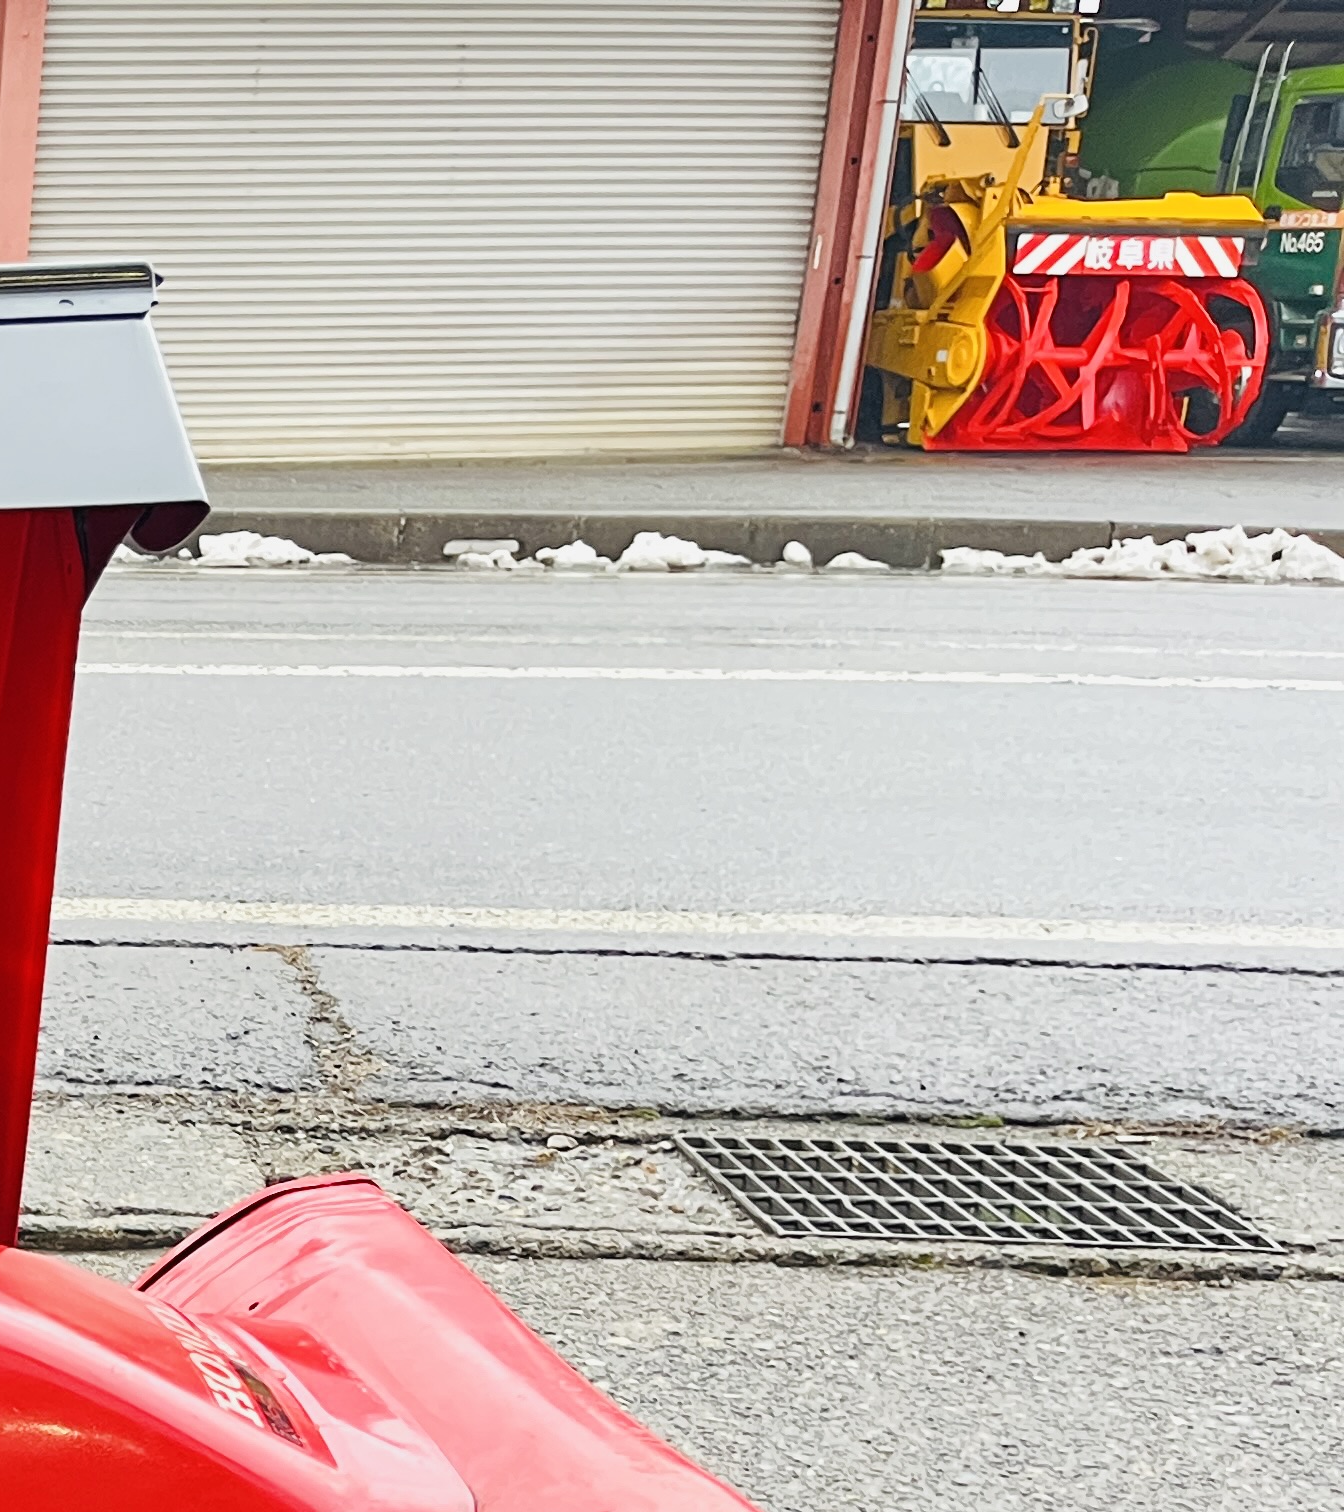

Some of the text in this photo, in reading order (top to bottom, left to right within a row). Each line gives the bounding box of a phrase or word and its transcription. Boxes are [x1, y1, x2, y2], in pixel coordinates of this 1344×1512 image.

[1084, 237, 1176, 270] 岐阜県
[145, 1303, 265, 1428] HOND
